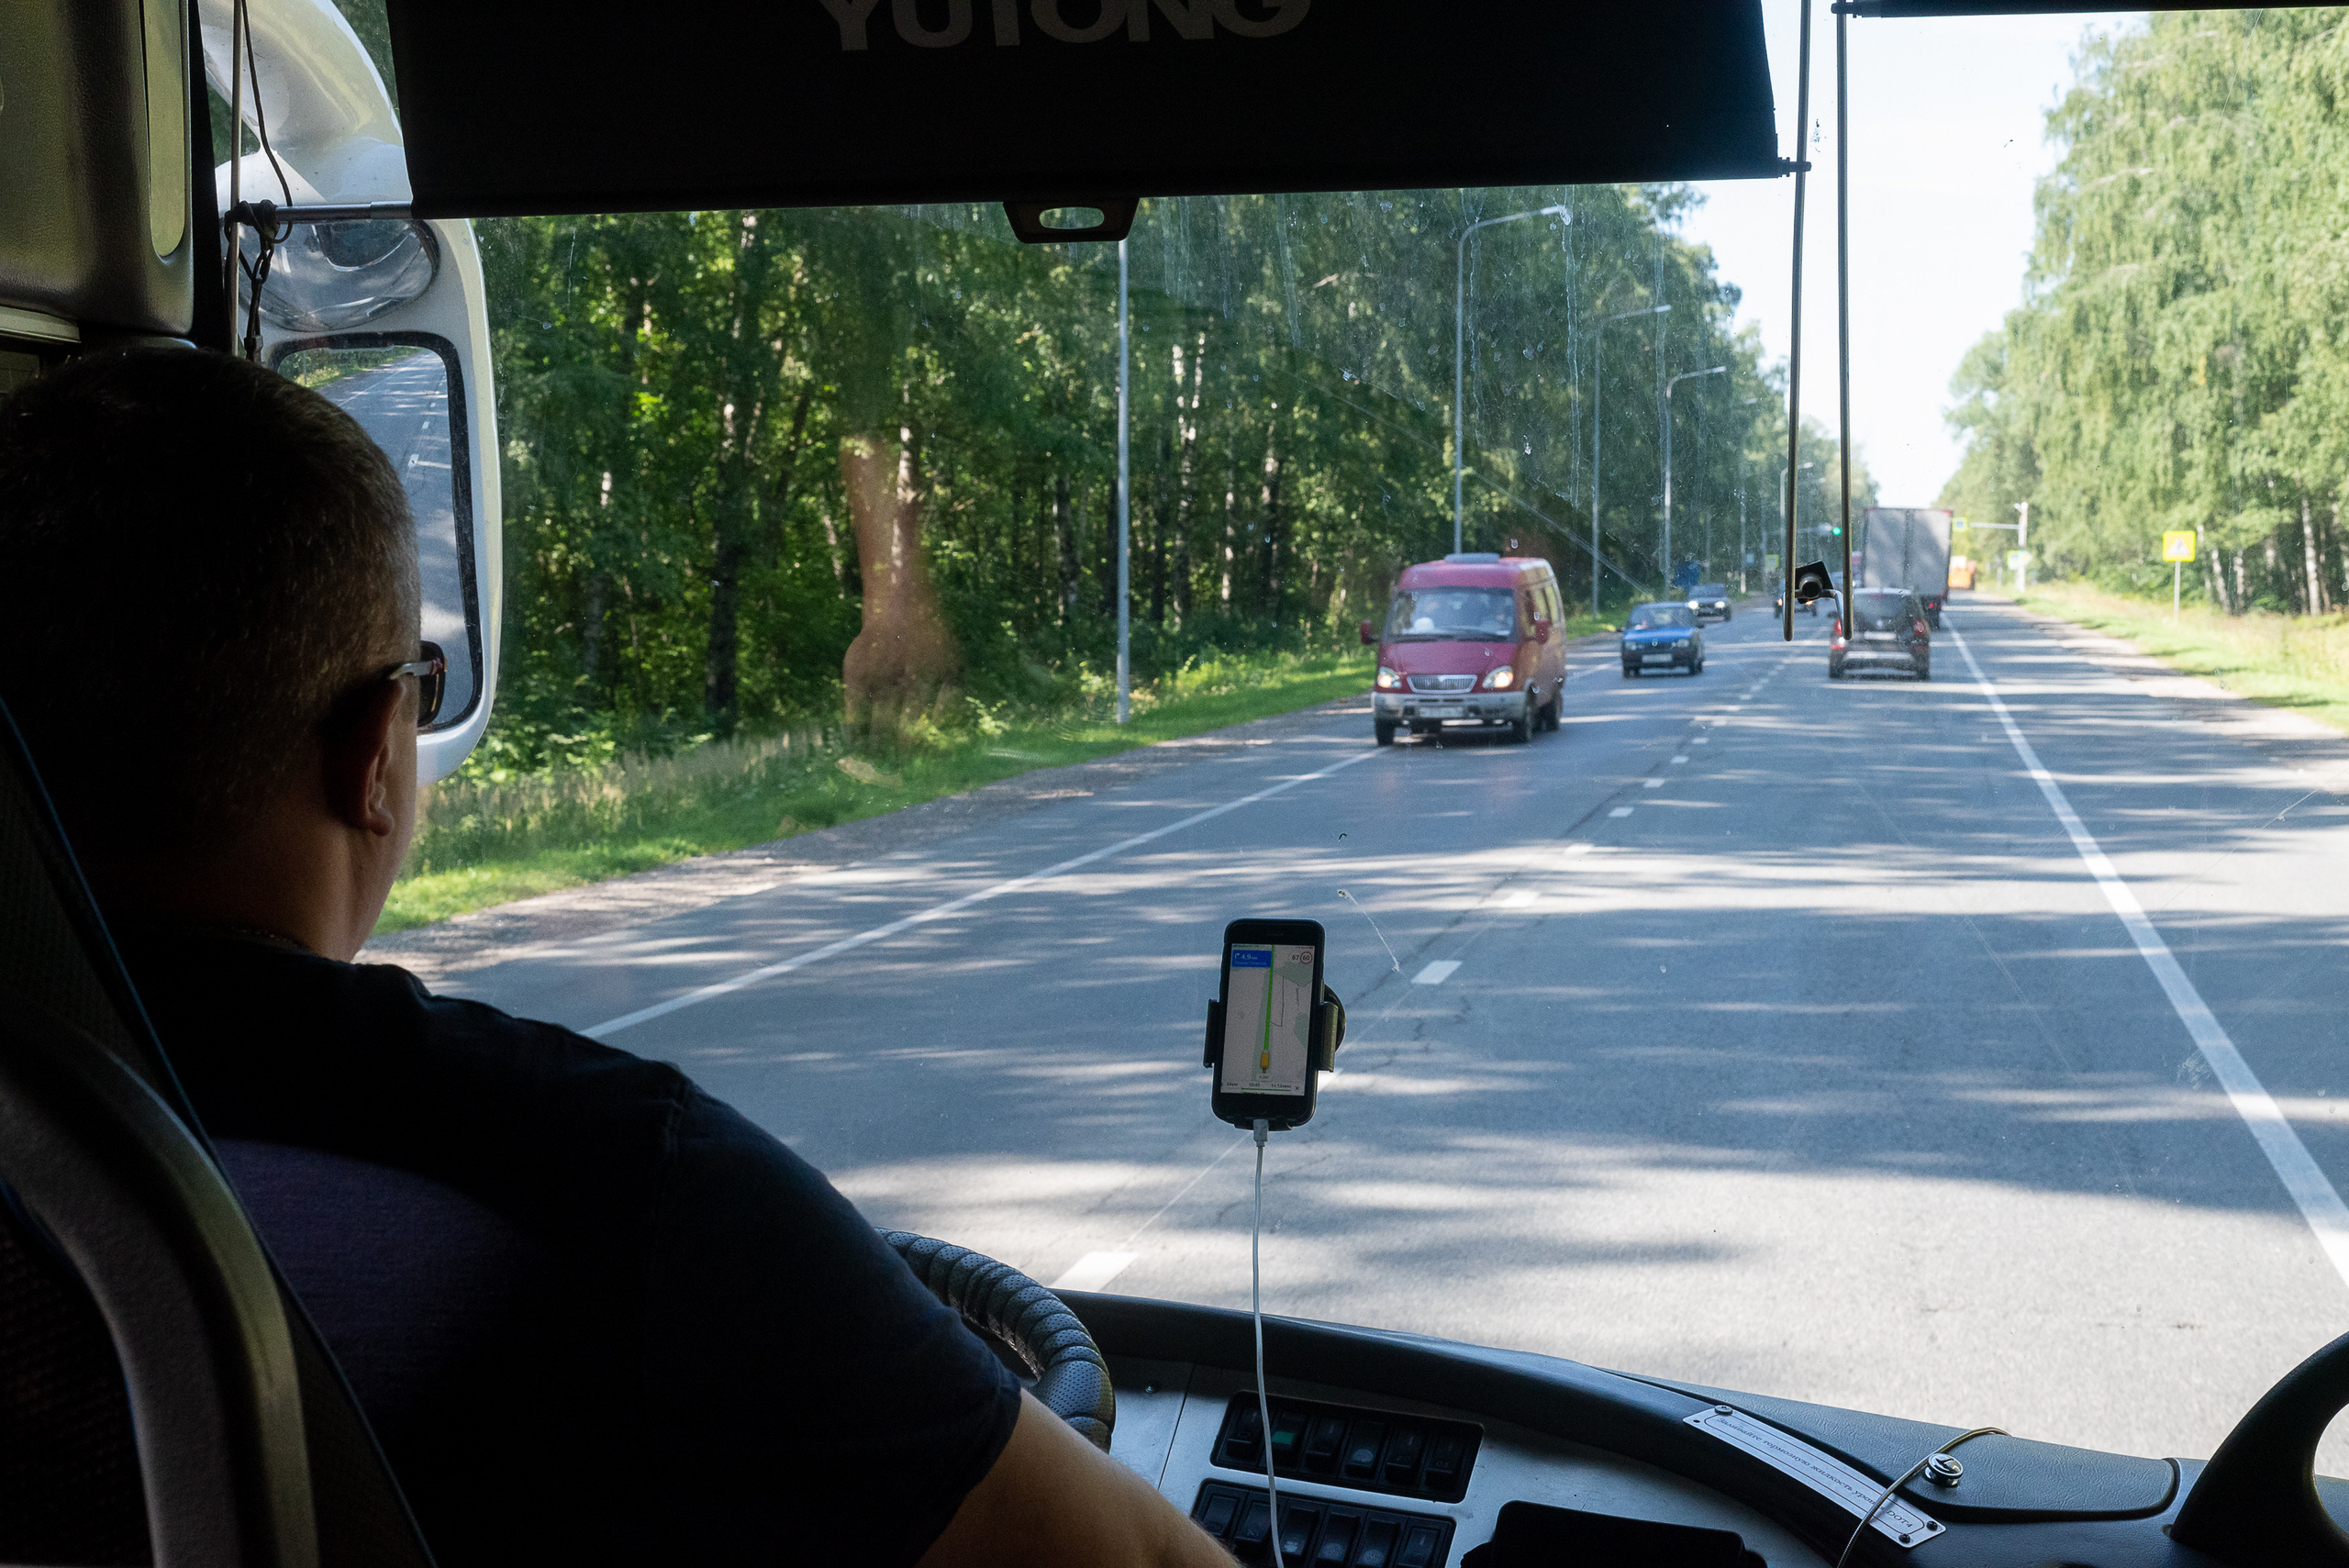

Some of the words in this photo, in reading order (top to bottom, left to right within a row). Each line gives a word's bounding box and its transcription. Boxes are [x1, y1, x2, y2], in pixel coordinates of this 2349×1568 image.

[1716, 1417, 1763, 1441] Заливайте
[1763, 1440, 1810, 1466] тормозную
[1810, 1464, 1853, 1491] жидкость
[1852, 1489, 1886, 1512] уровя
[1886, 1508, 1914, 1529] DOT4
